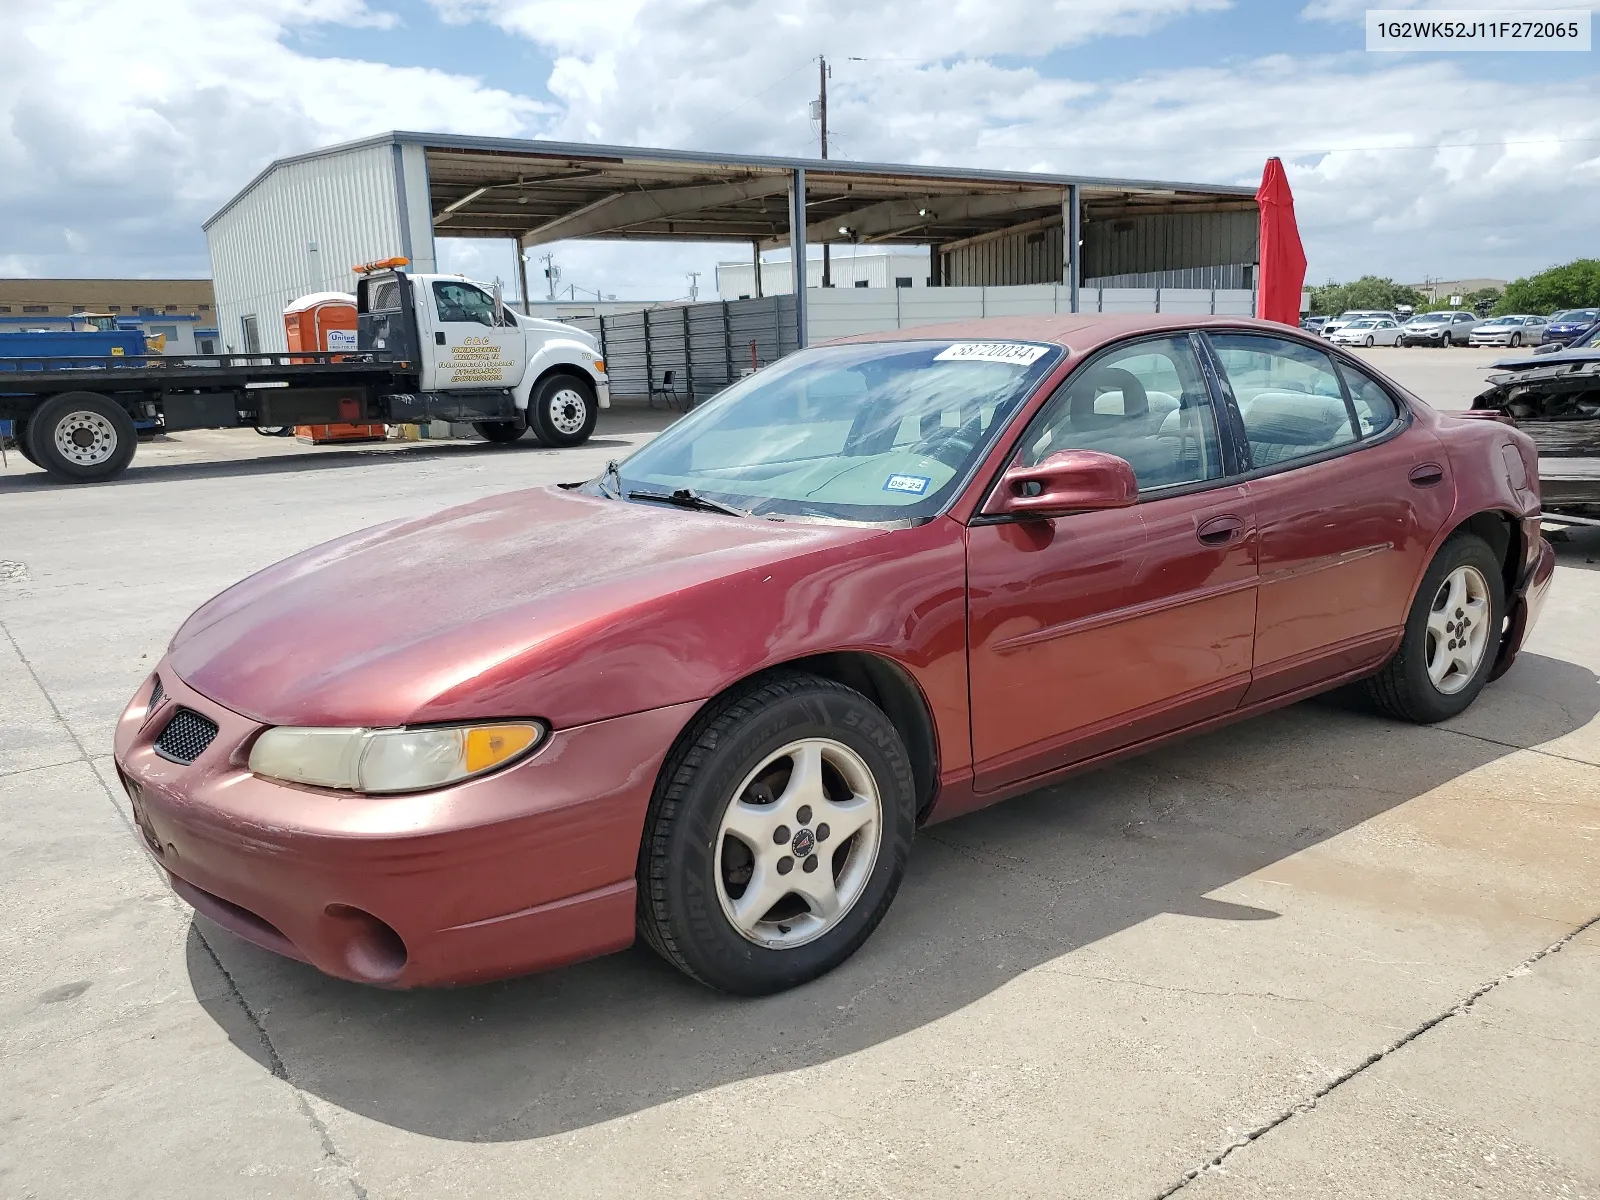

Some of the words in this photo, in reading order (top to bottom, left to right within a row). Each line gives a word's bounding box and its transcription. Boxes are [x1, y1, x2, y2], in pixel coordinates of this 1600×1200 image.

[464, 336, 472, 346] G
[473, 337, 481, 345] &
[482, 336, 489, 345] C
[841, 709, 913, 822] SENTURY
